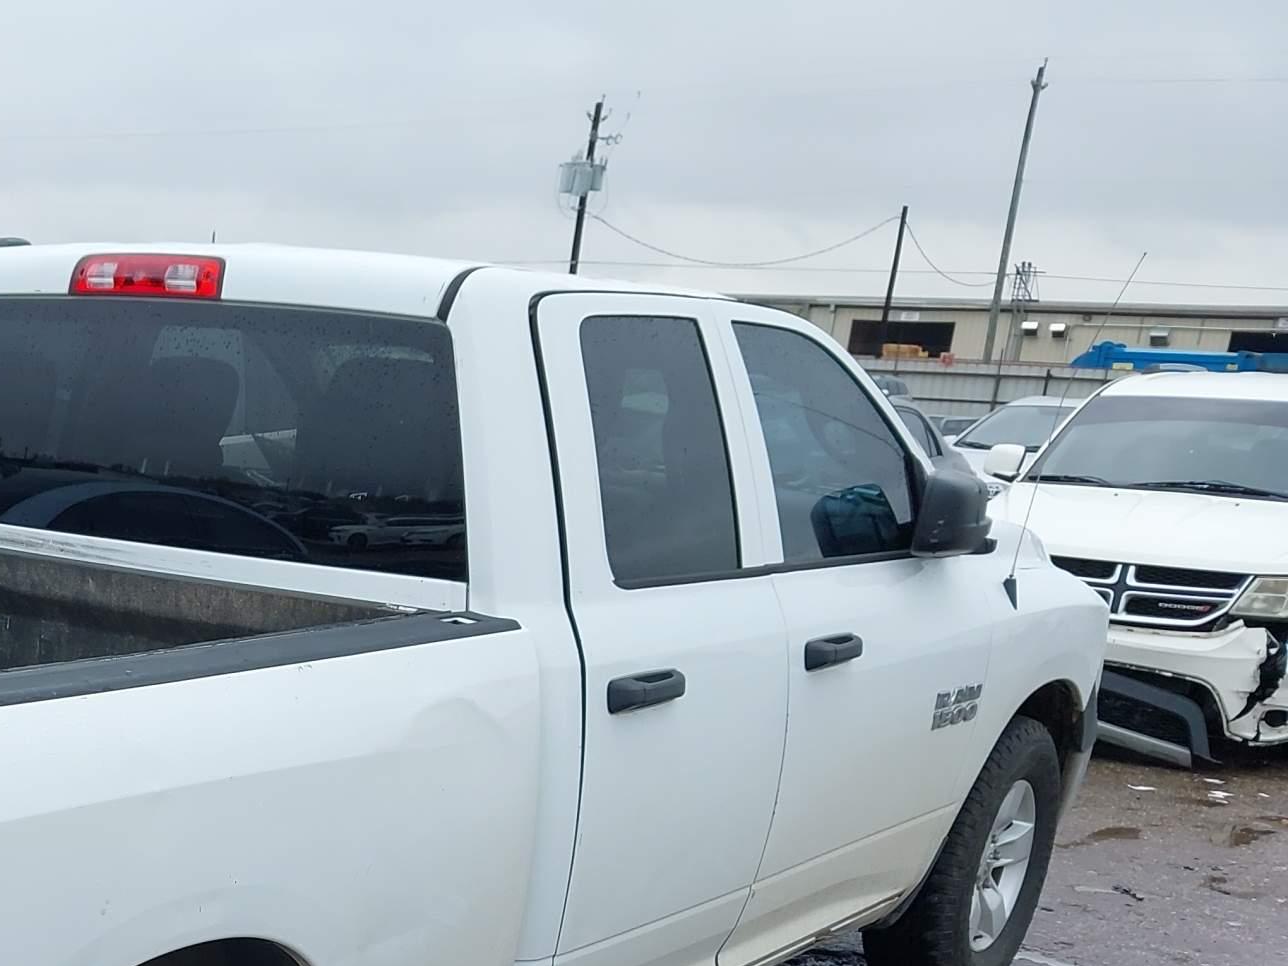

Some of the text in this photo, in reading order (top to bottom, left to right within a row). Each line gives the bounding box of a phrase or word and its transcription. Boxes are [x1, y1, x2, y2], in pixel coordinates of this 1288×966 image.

[1158, 602, 1202, 611] DODGE
[934, 684, 983, 711] RAM
[931, 701, 978, 731] 1500
